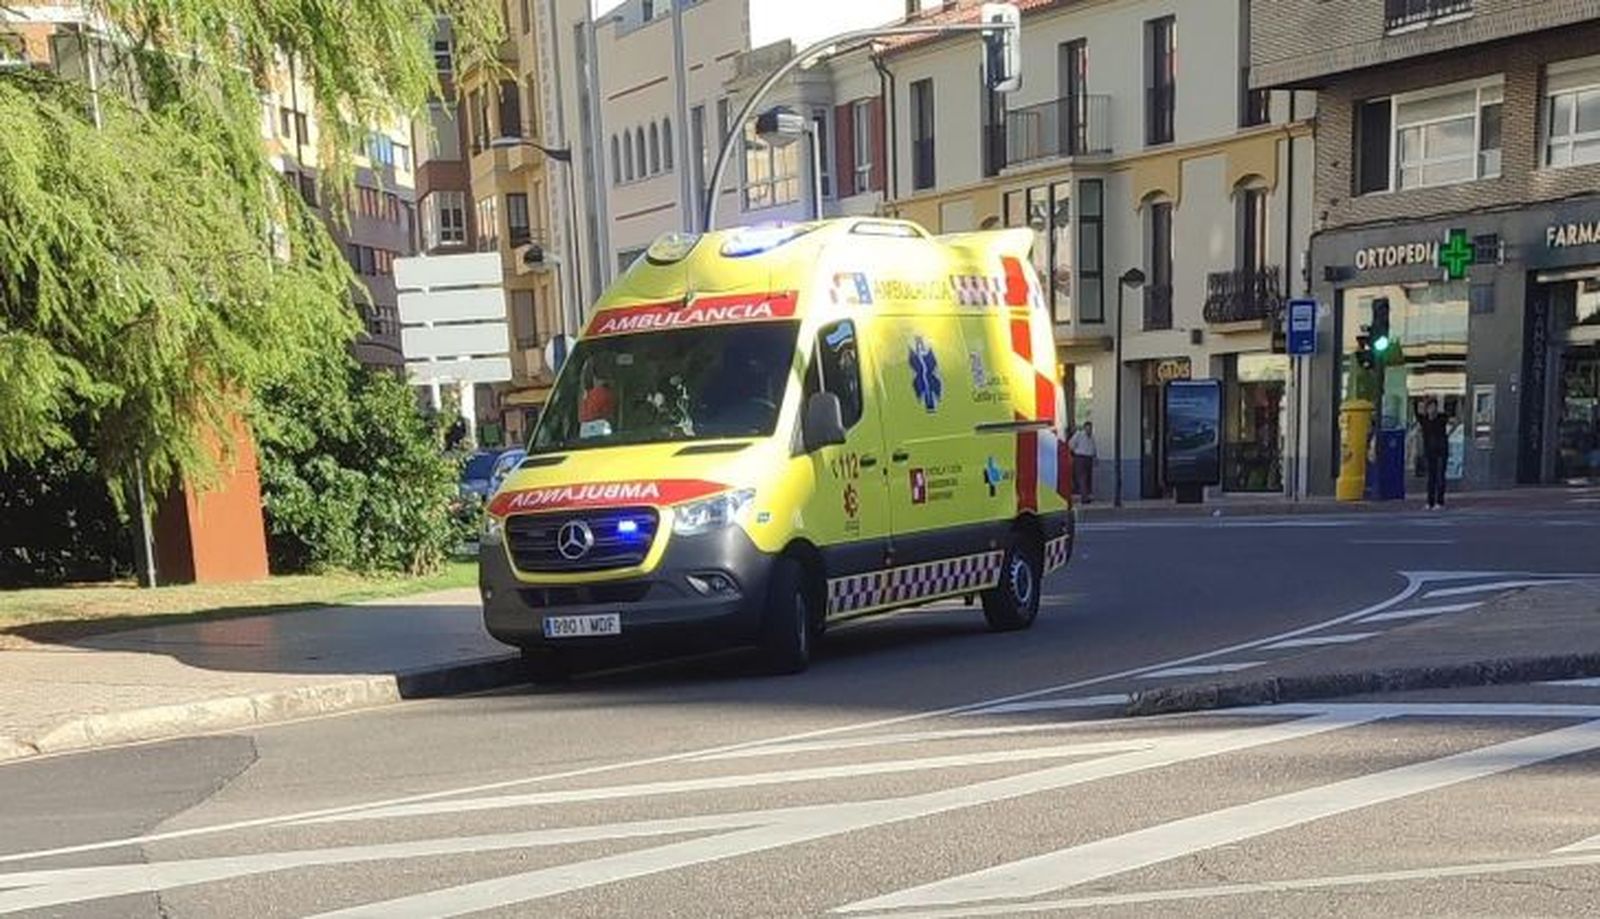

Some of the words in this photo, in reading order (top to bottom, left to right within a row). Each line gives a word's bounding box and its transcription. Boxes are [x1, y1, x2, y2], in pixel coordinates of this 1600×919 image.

[1355, 241, 1437, 269] ORTOPEDI
[600, 302, 772, 332] AMBULANCIA
[839, 452, 859, 480] 112
